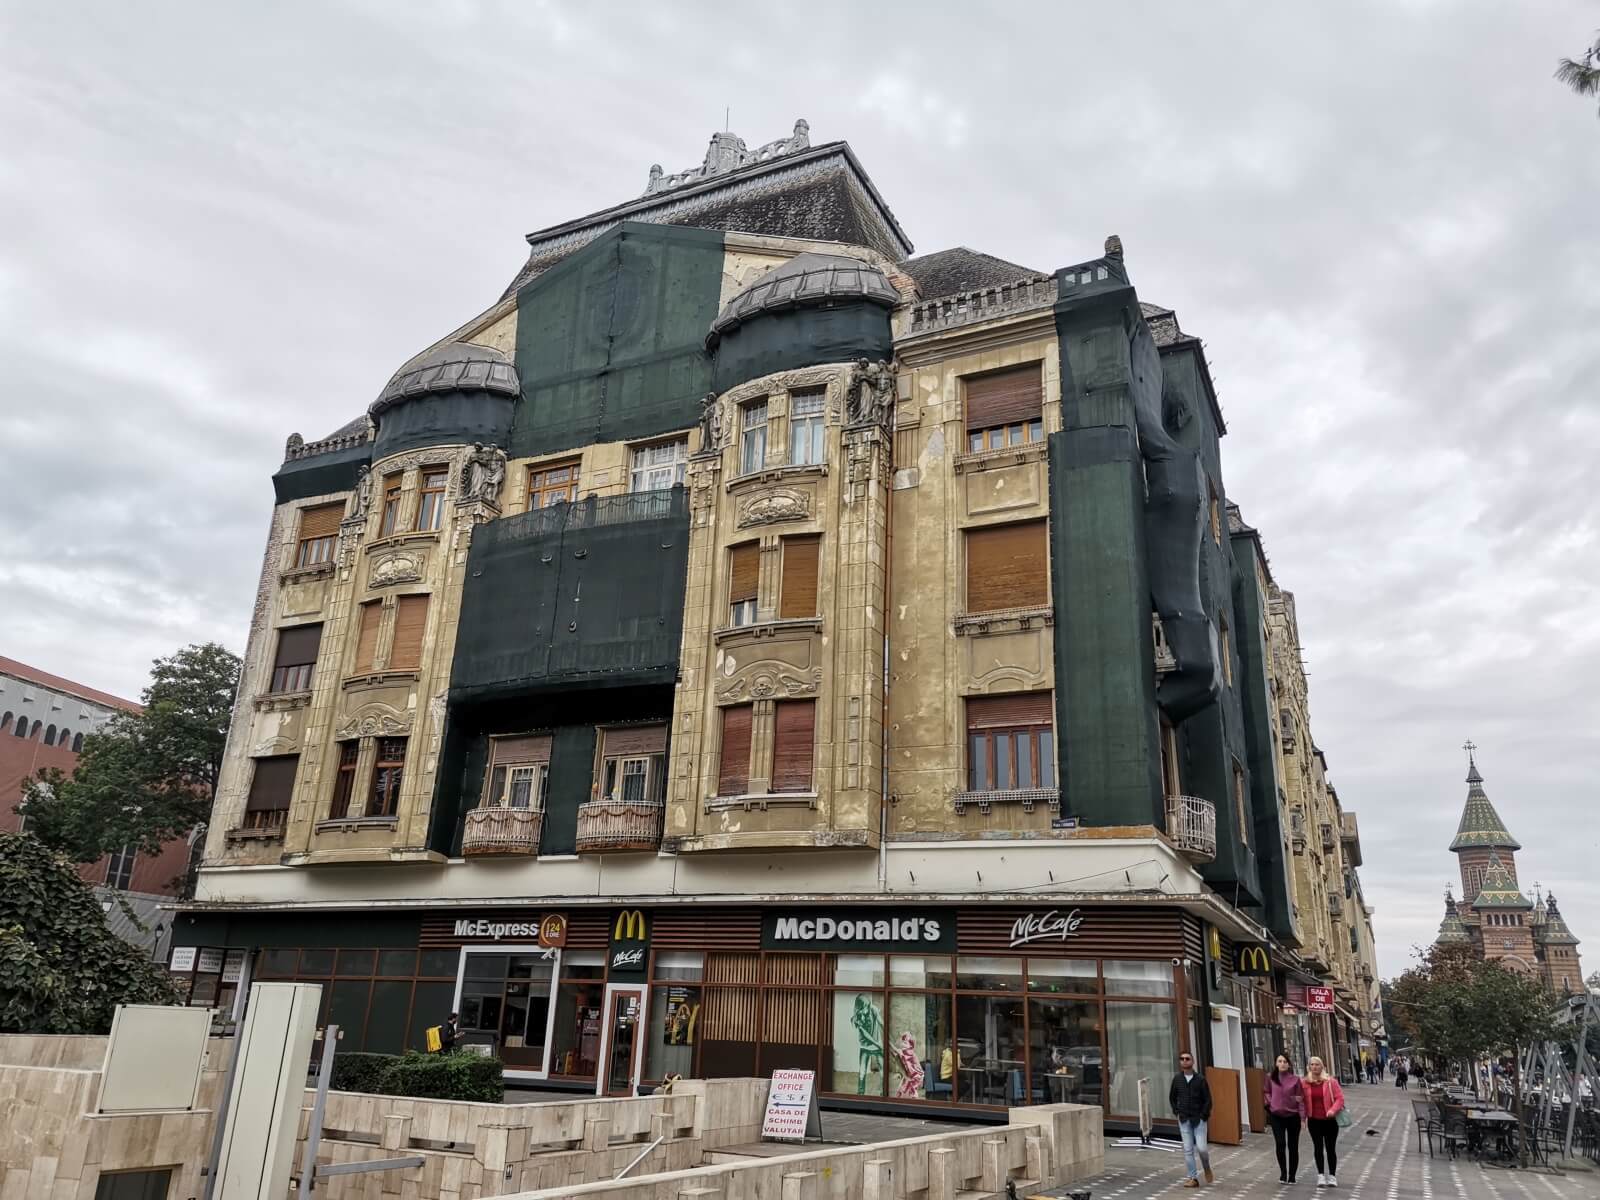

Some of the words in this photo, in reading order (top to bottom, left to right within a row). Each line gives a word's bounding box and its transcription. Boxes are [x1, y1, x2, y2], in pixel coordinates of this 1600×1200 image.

[454, 919, 540, 940] McExpress
[550, 923, 561, 932] 24
[774, 918, 941, 941] McDonald's
